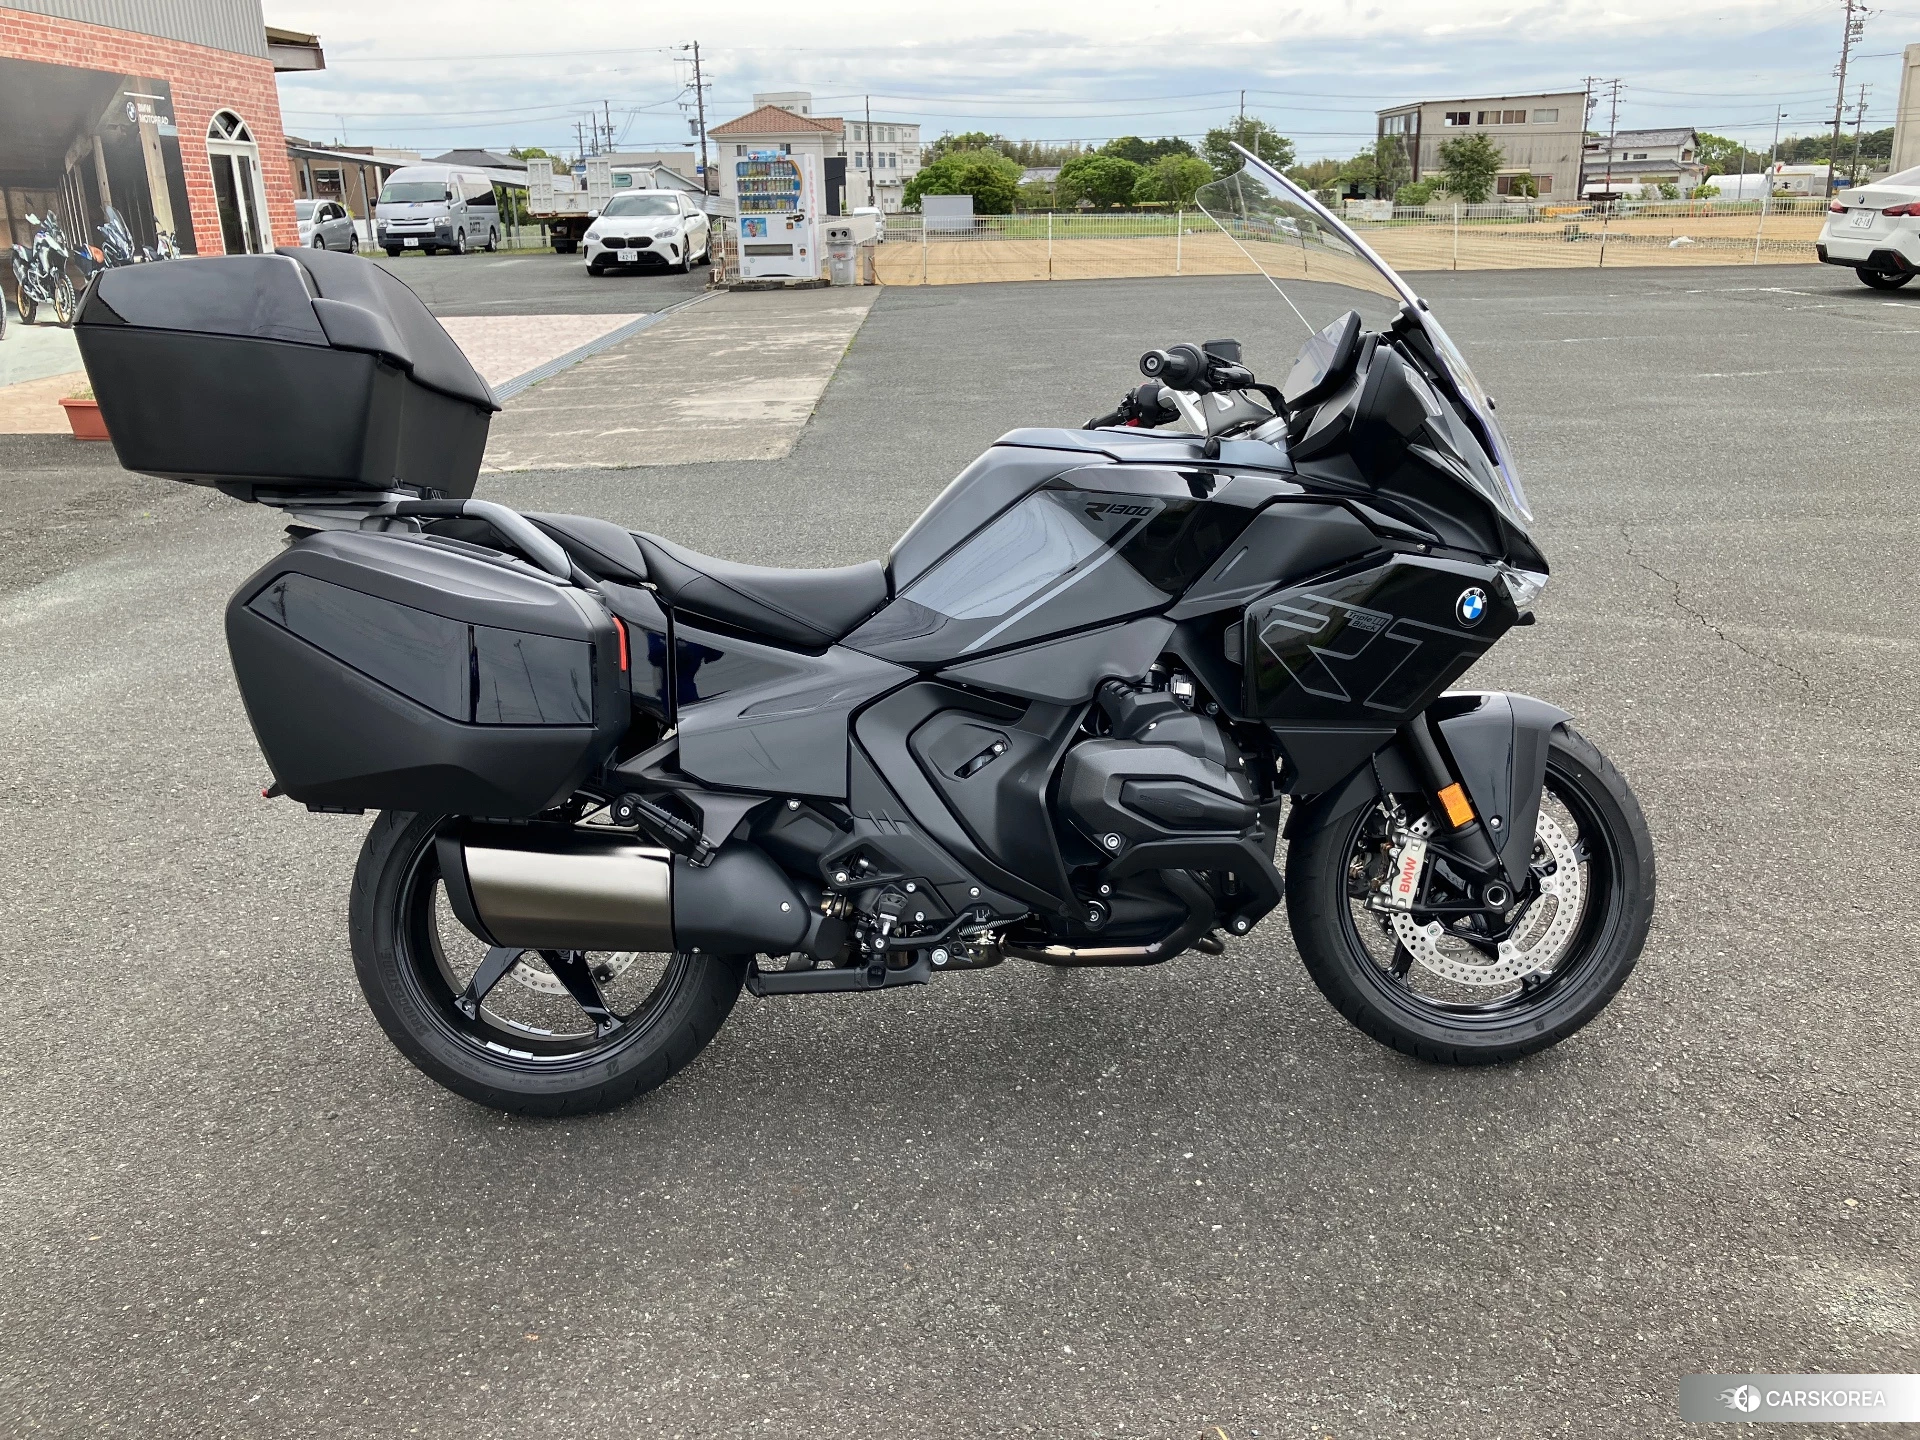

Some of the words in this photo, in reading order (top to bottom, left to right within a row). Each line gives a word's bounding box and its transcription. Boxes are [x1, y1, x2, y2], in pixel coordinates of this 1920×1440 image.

[1464, 589, 1487, 603] BMW
[1349, 612, 1373, 622] Triple
[1352, 621, 1377, 631] Black
[1399, 857, 1417, 893] BMW
[381, 951, 432, 1037] BRIDGESTONE
